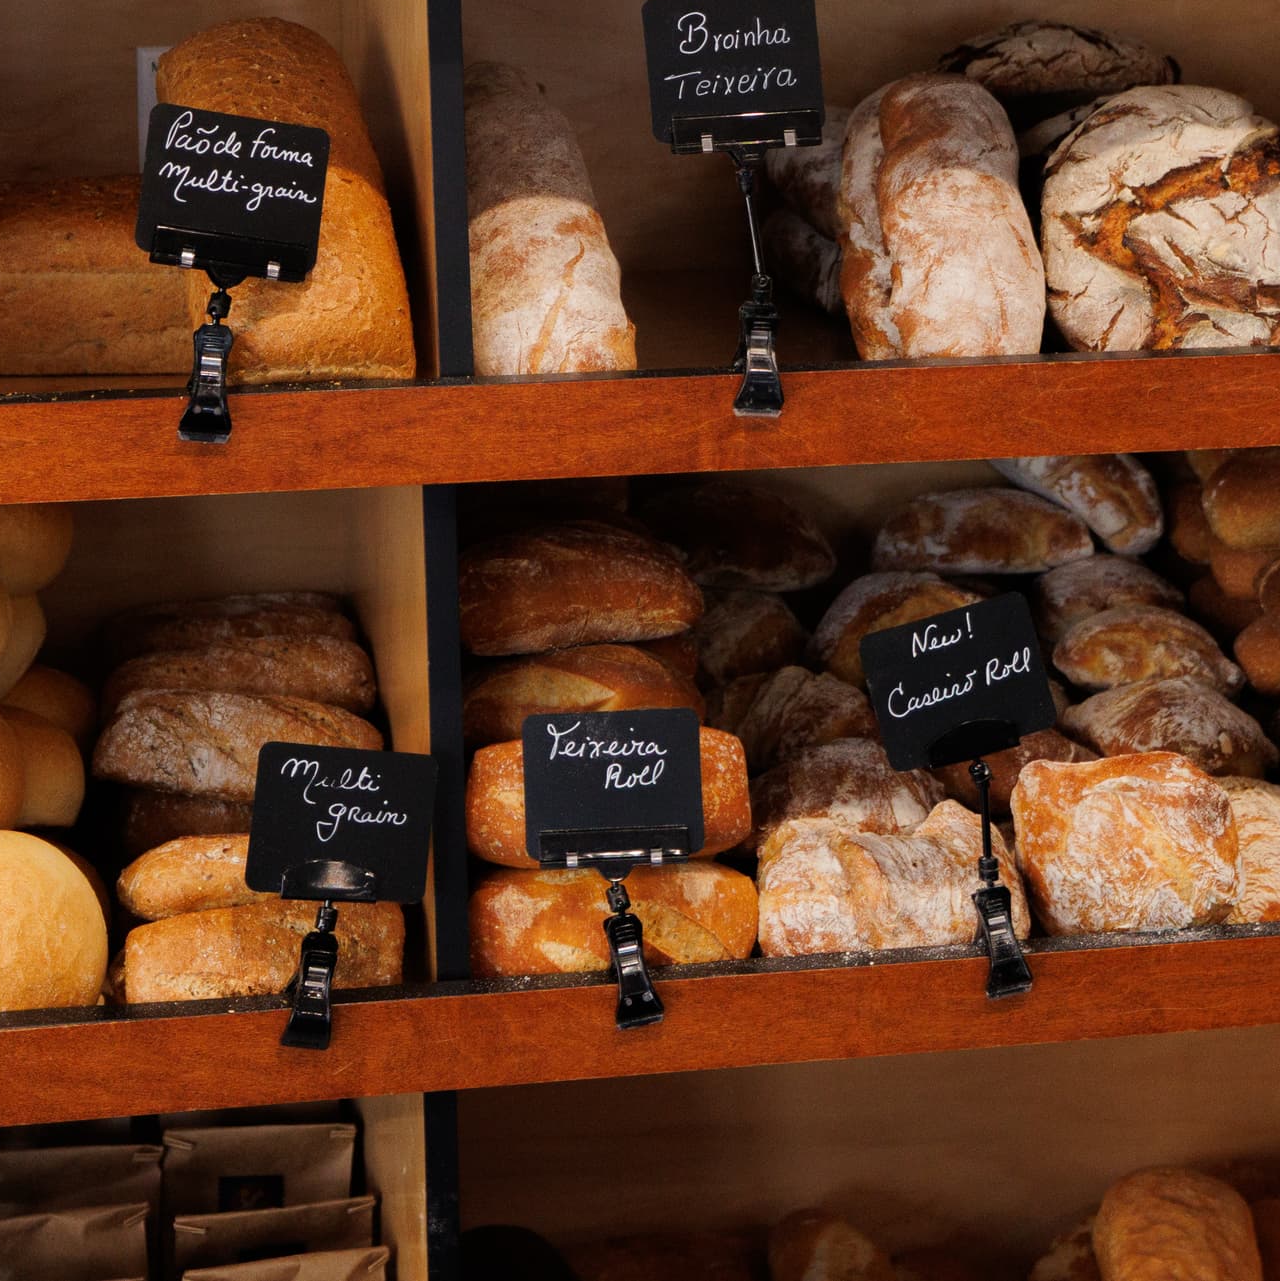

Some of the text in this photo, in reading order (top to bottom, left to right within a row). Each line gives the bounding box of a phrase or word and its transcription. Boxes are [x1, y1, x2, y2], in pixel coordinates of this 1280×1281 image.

[677, 10, 792, 55] Broinha
[663, 65, 799, 100] Teixeira
[213, 127, 243, 157] de
[910, 611, 975, 659] New!
[886, 647, 1031, 719] Caseiro Roll
[545, 721, 669, 761] Teixeira
[279, 757, 382, 806] Multi
[603, 762, 666, 791] Roll
